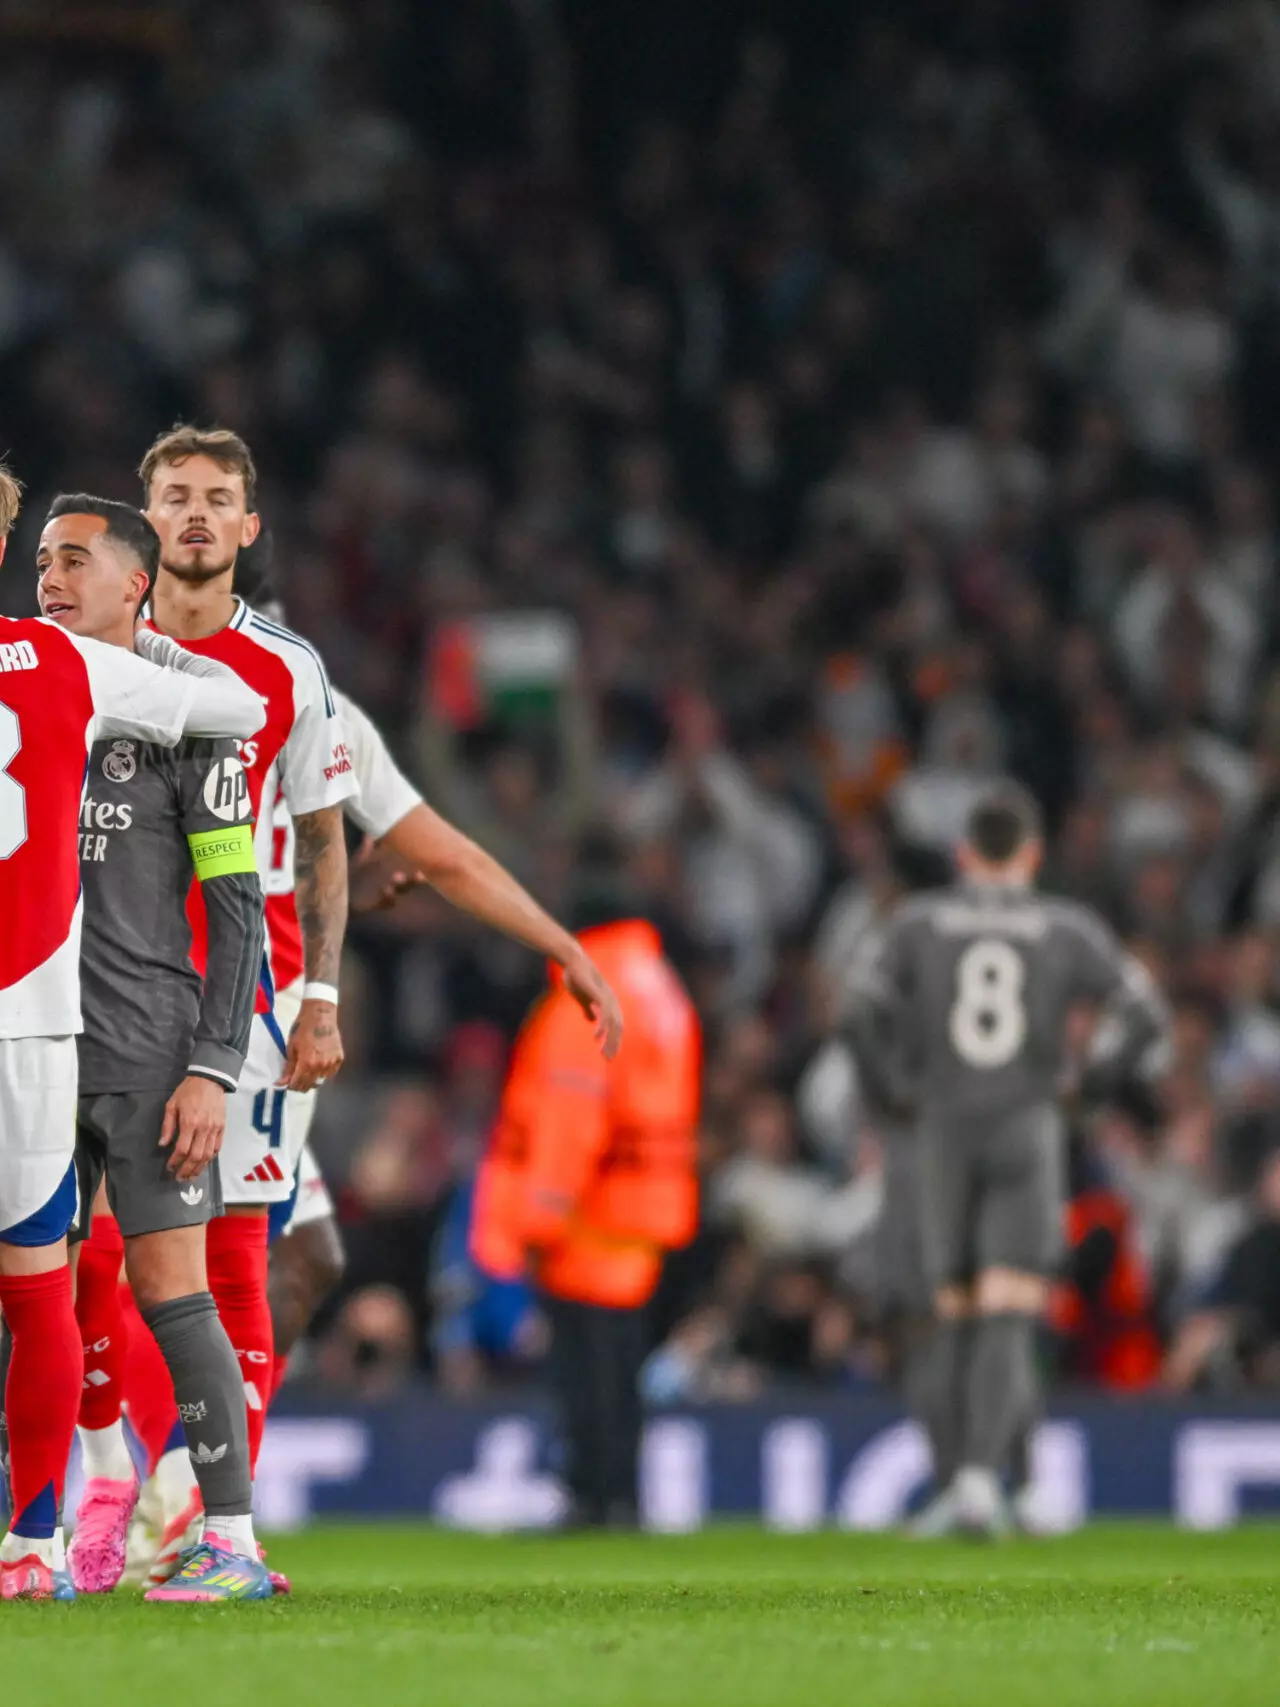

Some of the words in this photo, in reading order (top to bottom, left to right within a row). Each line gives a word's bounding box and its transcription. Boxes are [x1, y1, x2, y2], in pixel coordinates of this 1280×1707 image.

[212, 757, 249, 821] hp
[78, 796, 133, 830] tes
[77, 833, 108, 862] TER
[195, 841, 242, 858] RESPECT
[950, 939, 1026, 1069] 8
[252, 1087, 286, 1148] 4
